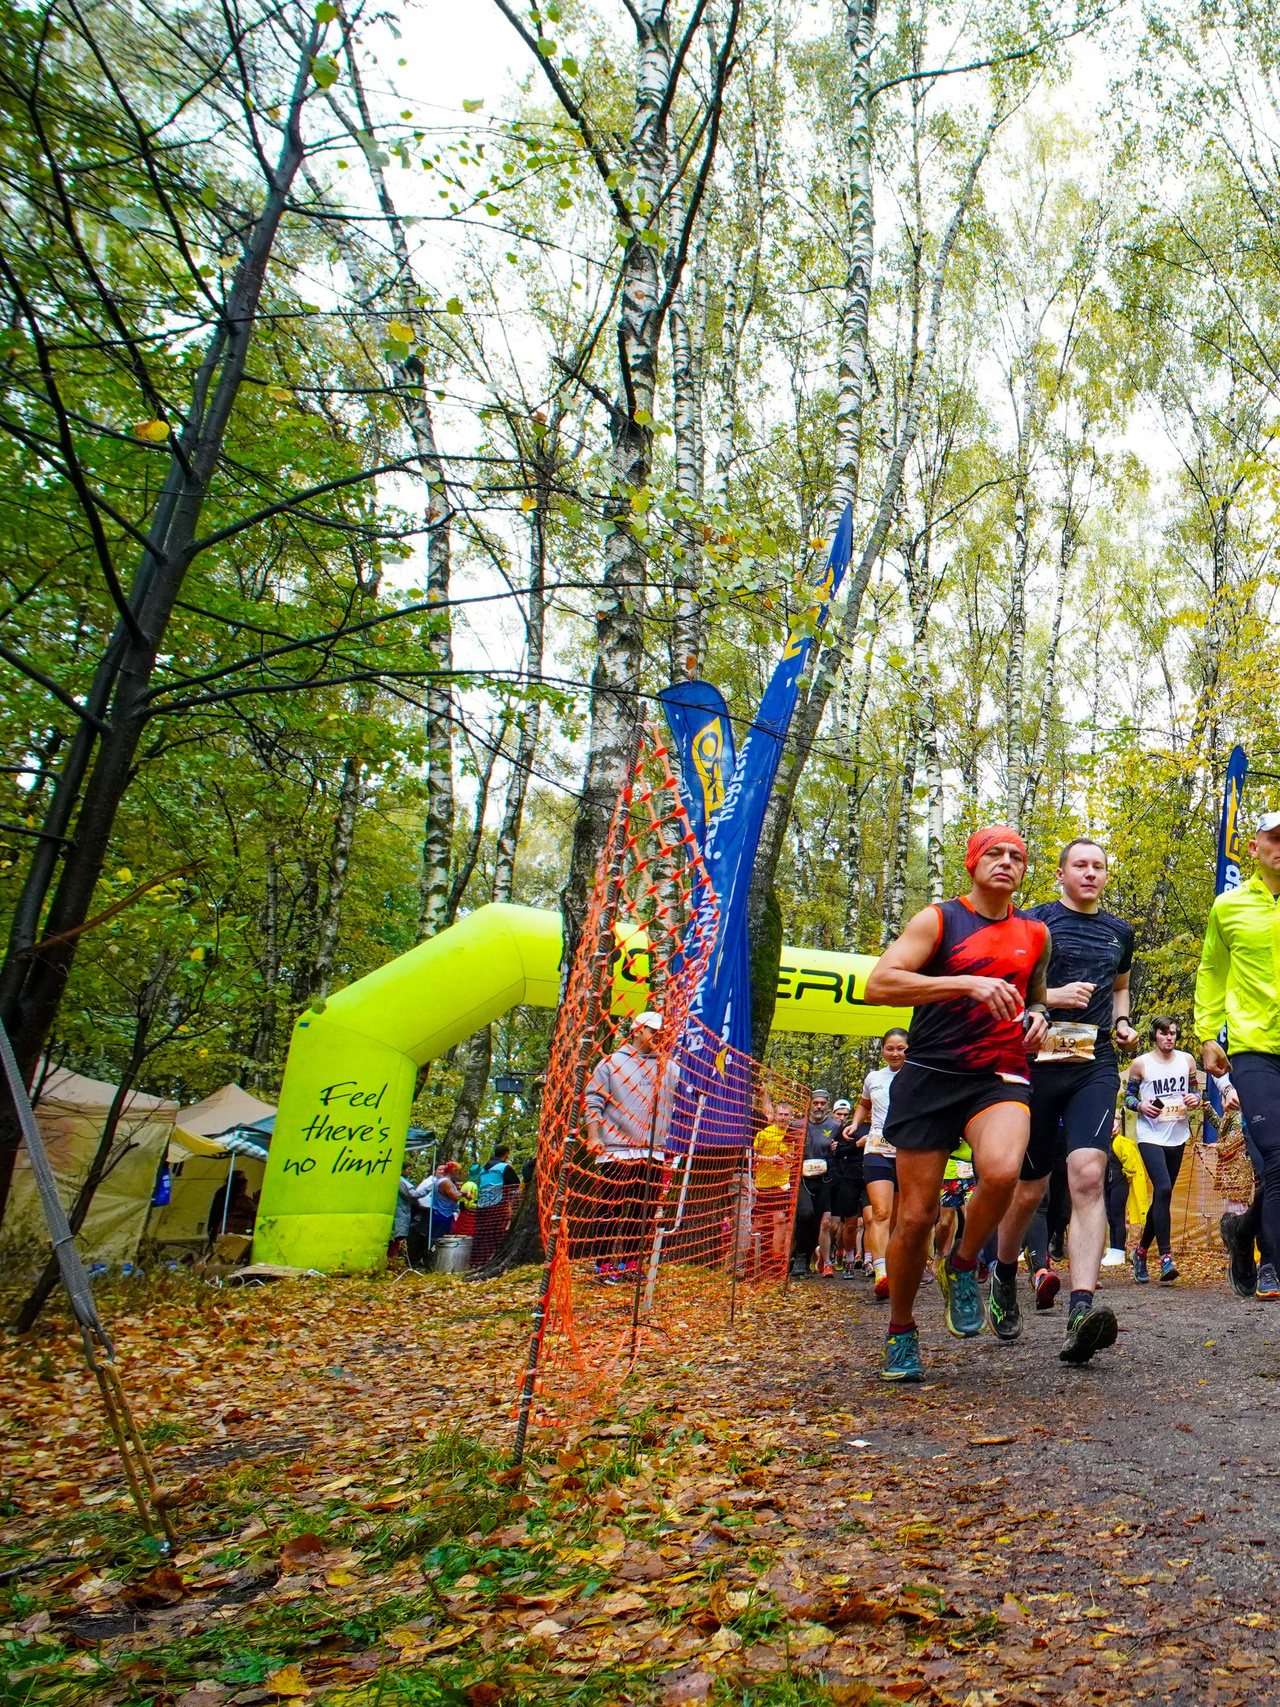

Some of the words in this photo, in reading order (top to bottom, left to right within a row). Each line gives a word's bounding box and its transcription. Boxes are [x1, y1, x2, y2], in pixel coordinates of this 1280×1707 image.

[1059, 1037, 1076, 1048] 19
[320, 1081, 388, 1109] Feel
[1152, 1076, 1185, 1095] M42.2
[301, 1114, 390, 1143] there's
[283, 1156, 316, 1176] no
[331, 1145, 393, 1176] limit
